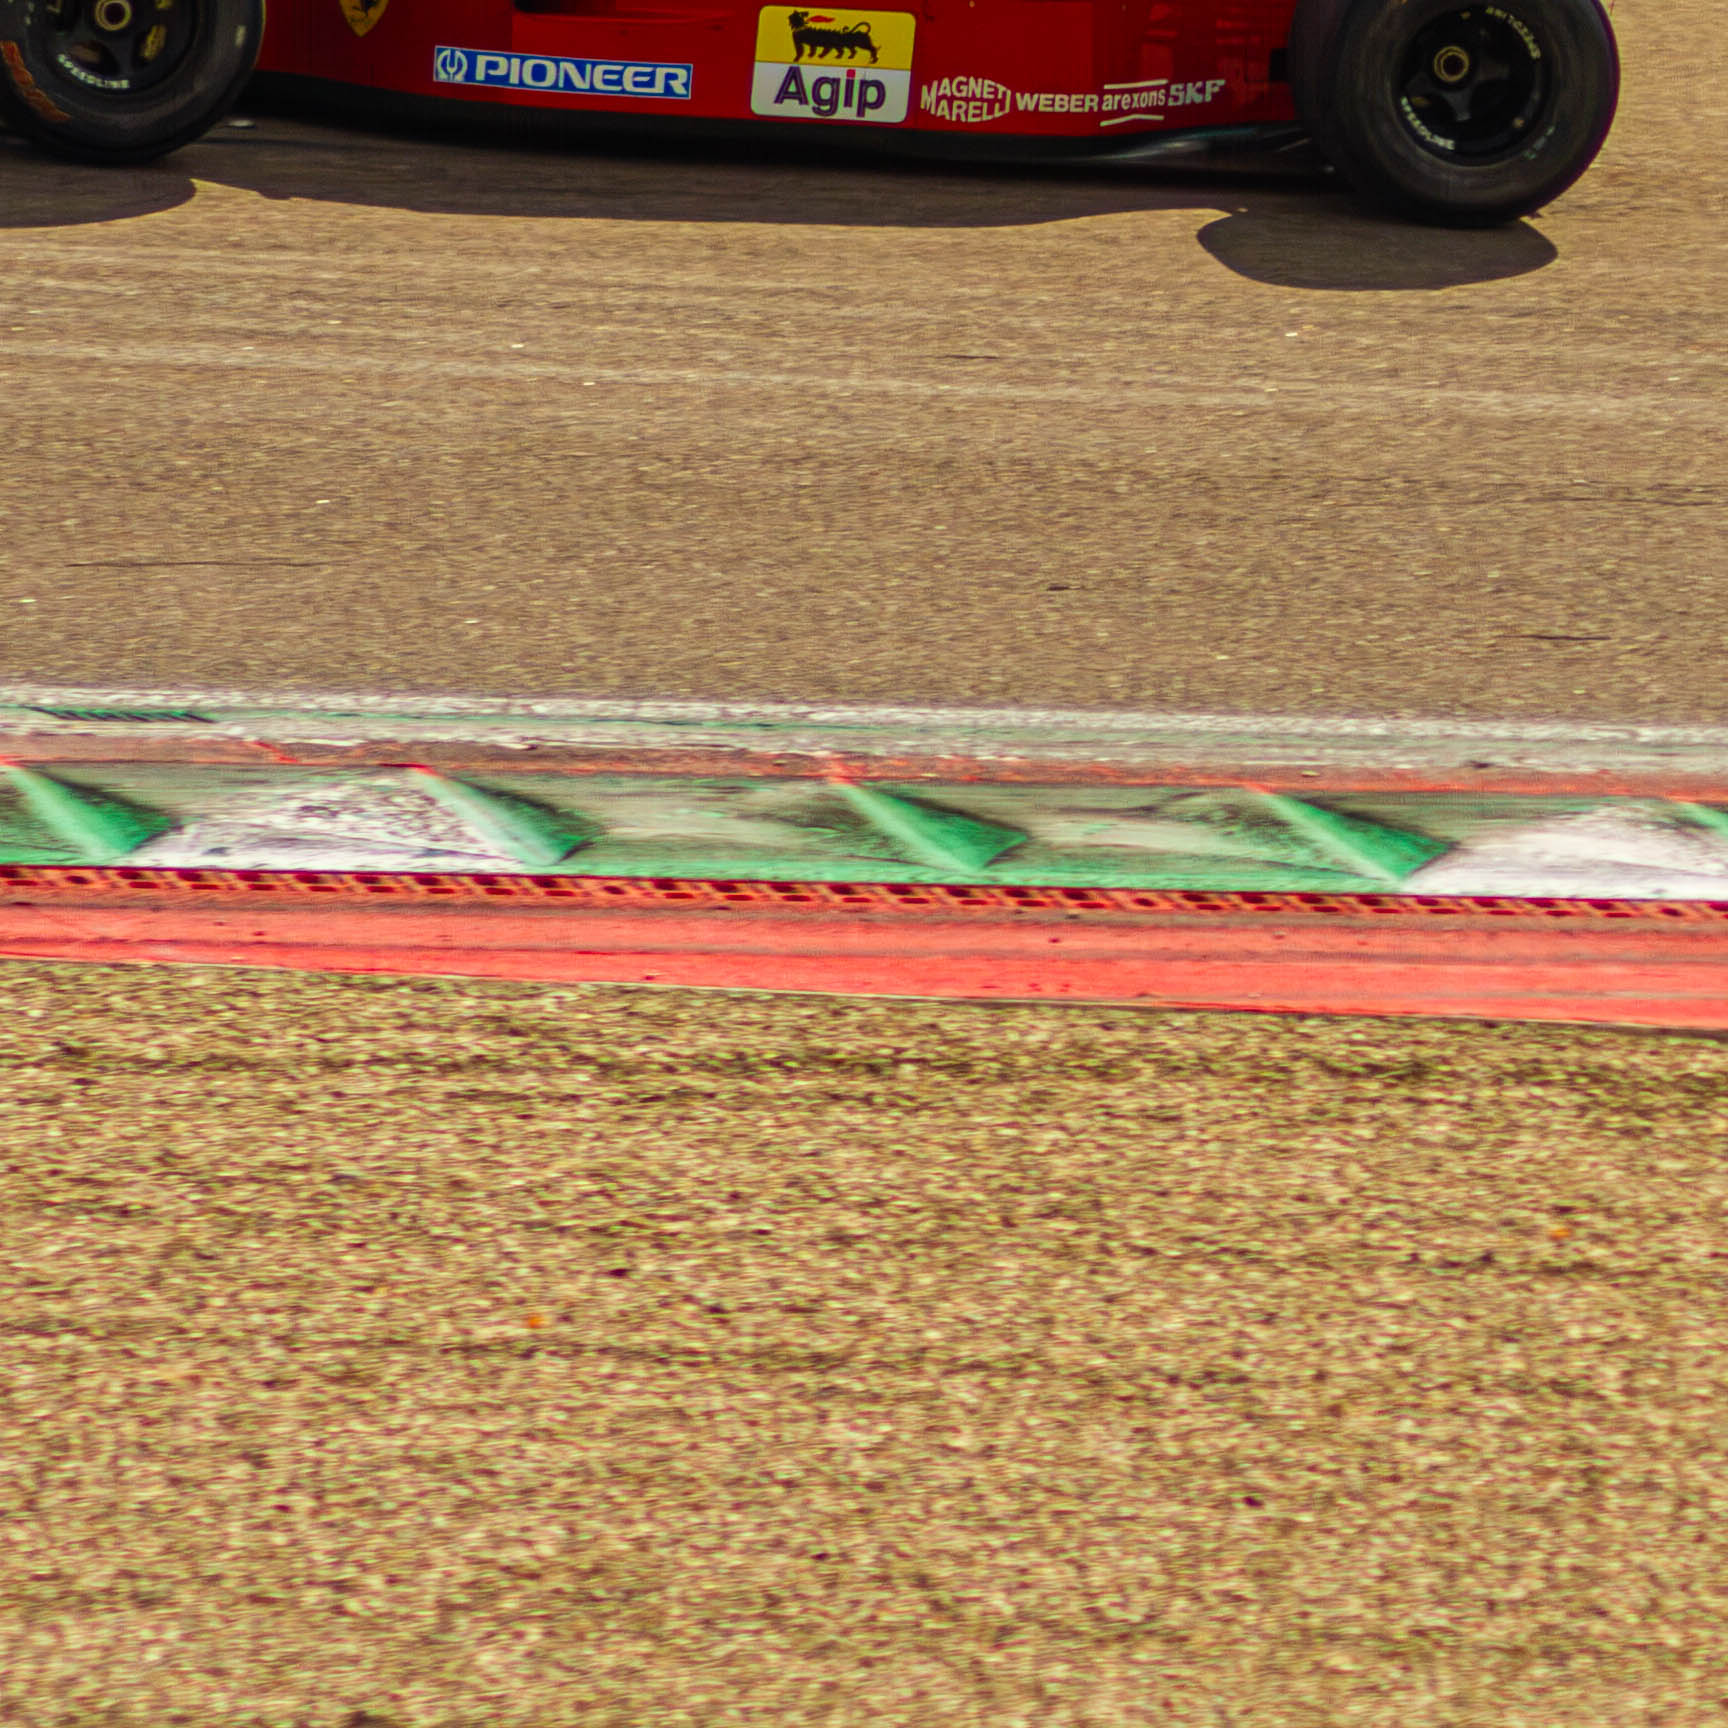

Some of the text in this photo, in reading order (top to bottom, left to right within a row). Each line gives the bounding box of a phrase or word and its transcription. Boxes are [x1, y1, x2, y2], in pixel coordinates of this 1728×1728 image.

[474, 54, 690, 96] PIONEER
[773, 65, 887, 118] Agip
[1015, 91, 1099, 113] WEBER
[1101, 87, 1166, 112] arexons
[1167, 78, 1226, 107] SKF
